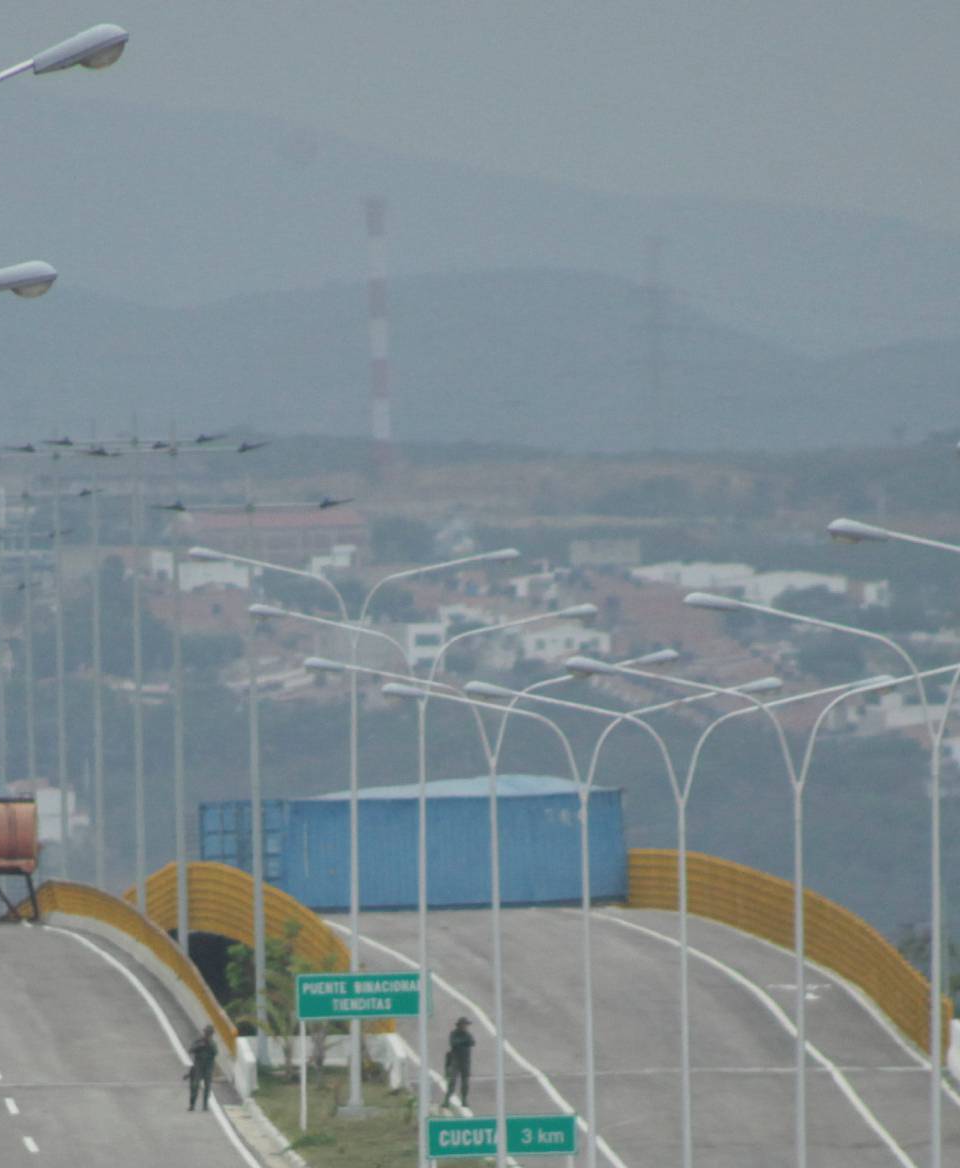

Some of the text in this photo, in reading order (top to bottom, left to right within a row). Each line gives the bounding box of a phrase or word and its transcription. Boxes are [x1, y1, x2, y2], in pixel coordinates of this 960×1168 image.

[302, 981, 347, 994] PUENTE
[332, 998, 392, 1011] TIENDITAS
[521, 1128, 533, 1144] 3
[537, 1128, 565, 1144] km
